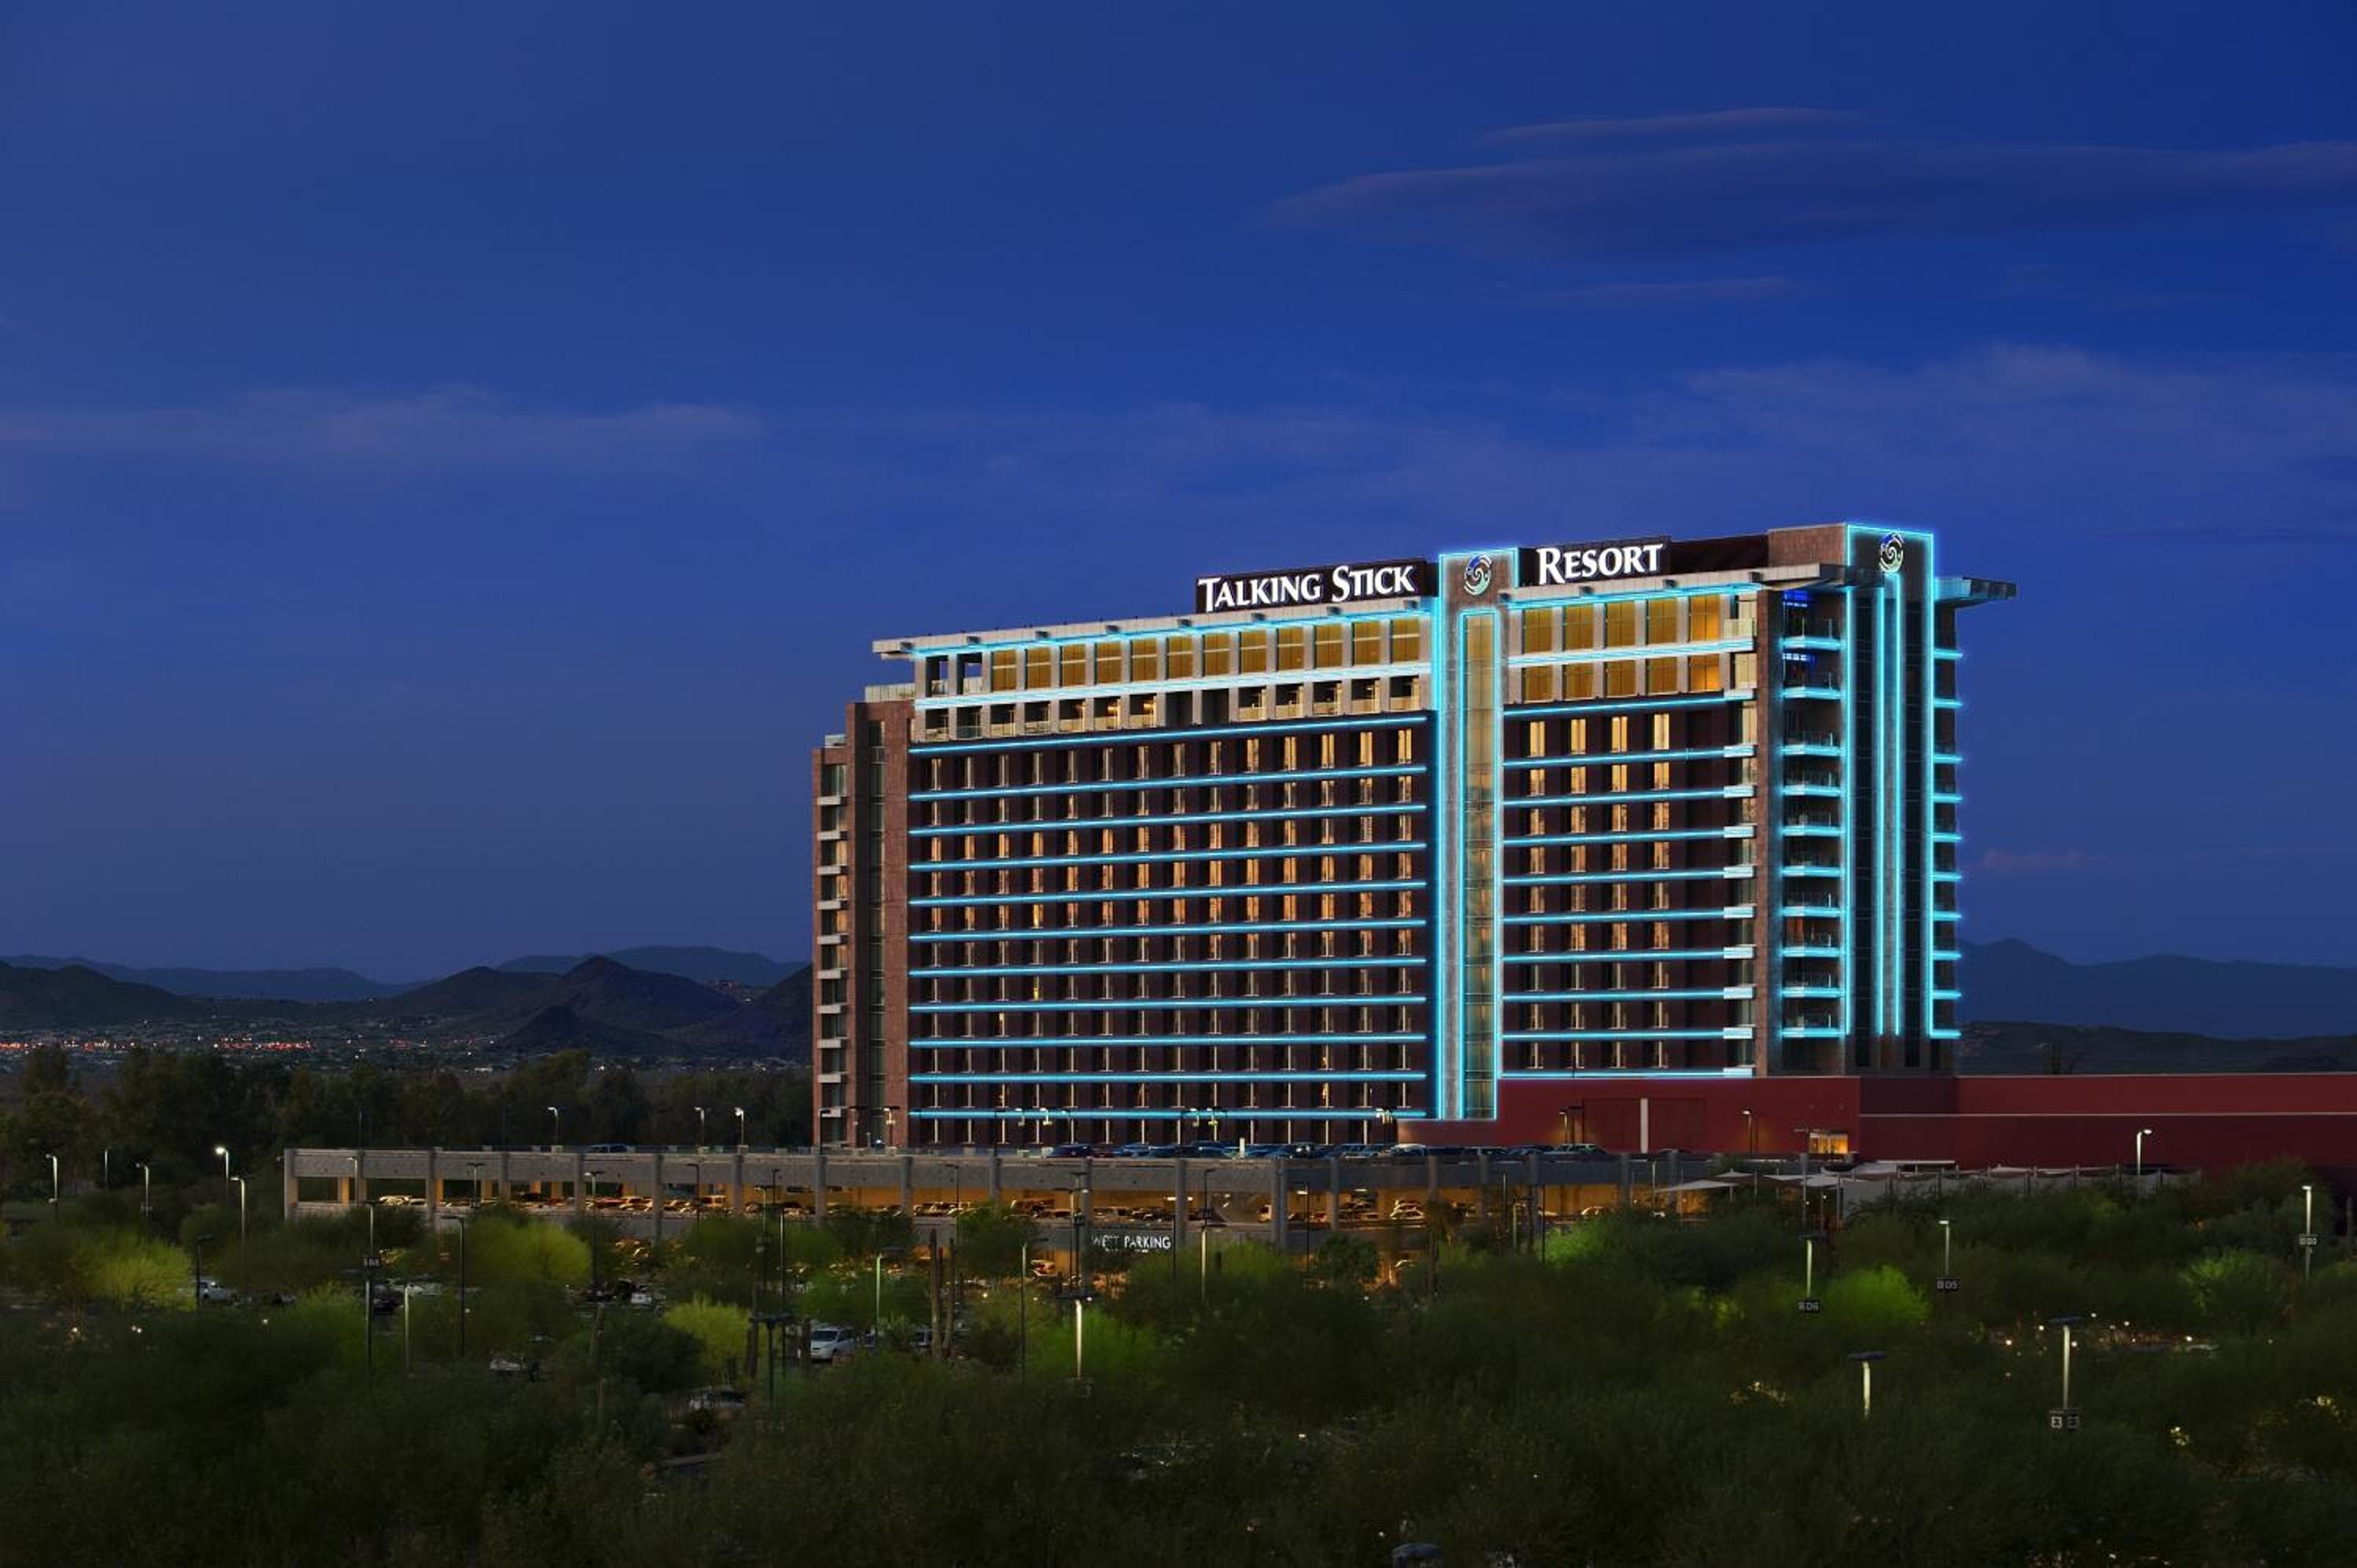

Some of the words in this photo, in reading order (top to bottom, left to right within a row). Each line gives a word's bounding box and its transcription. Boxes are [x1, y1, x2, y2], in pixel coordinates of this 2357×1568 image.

[1535, 544, 1663, 585] RESORT
[1198, 573, 1321, 613] TALKING
[1332, 565, 1415, 603] STICK
[1124, 1236, 1171, 1249] PARKING
